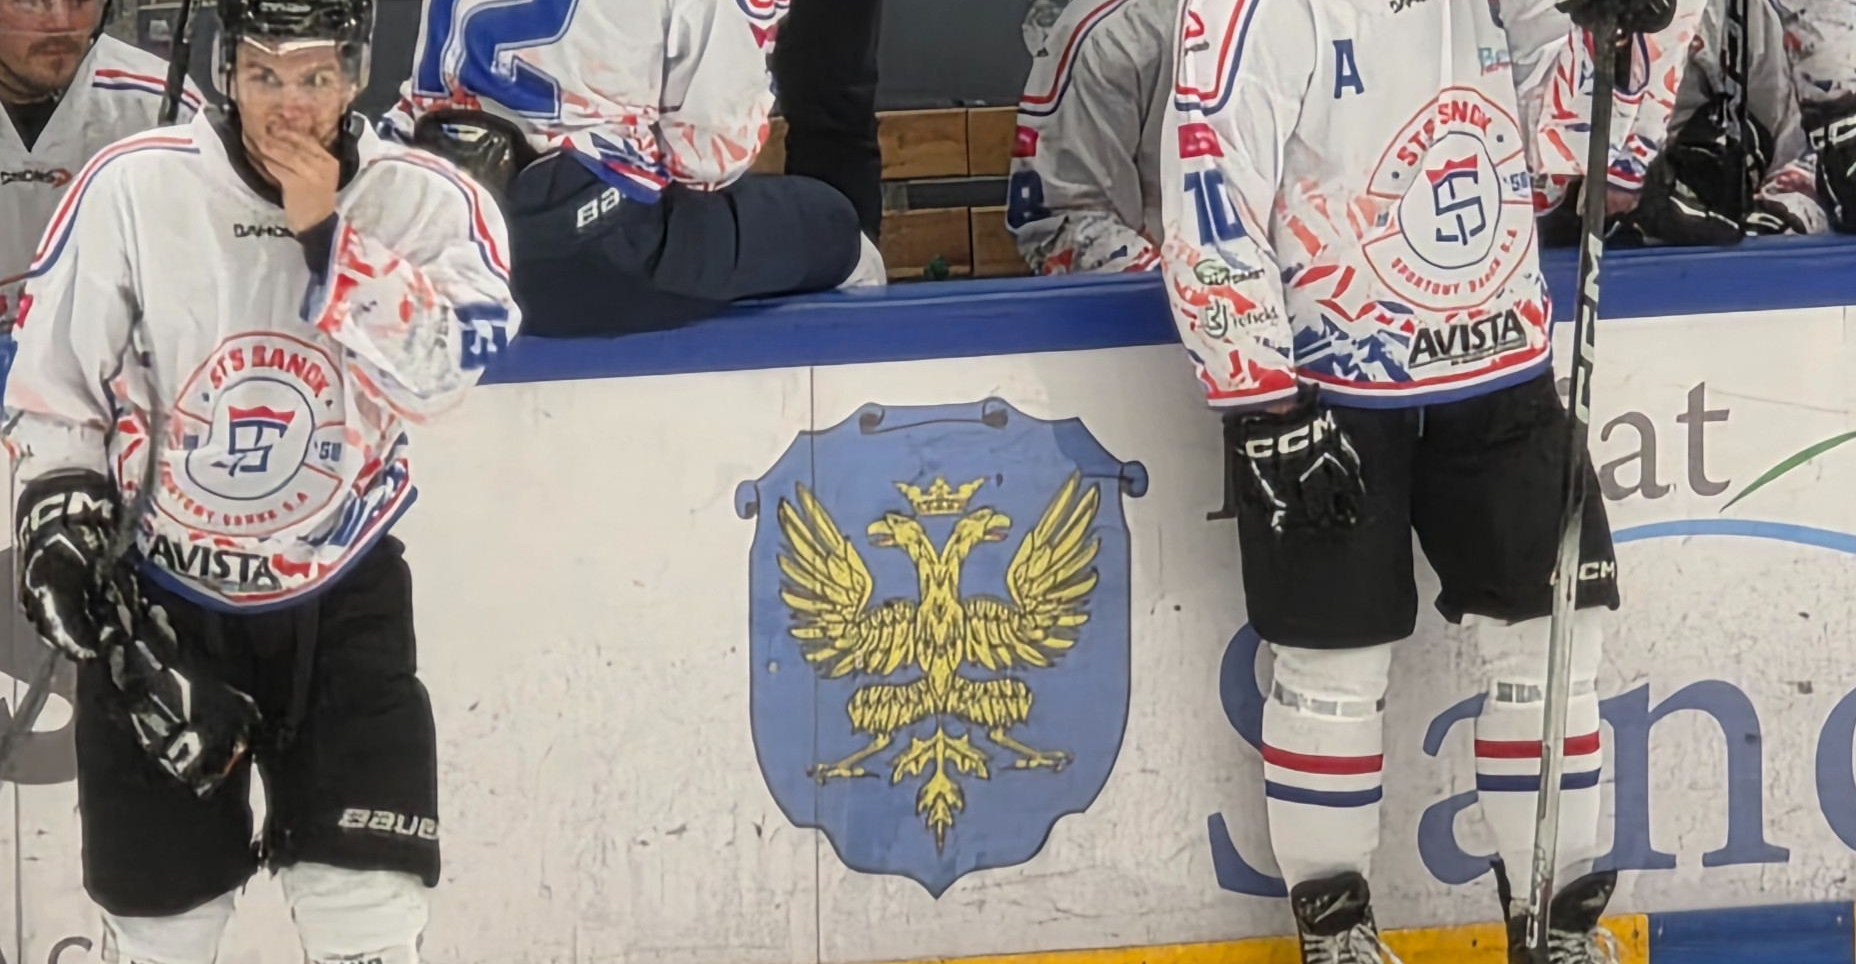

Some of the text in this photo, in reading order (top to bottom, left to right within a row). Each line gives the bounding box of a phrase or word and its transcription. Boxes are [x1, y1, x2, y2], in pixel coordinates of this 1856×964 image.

[1332, 39, 1364, 99] A
[1408, 308, 1524, 364] AVISTA
[1245, 409, 1336, 458] CCM
[18, 492, 114, 540] CM
[149, 534, 283, 590] AVISTA
